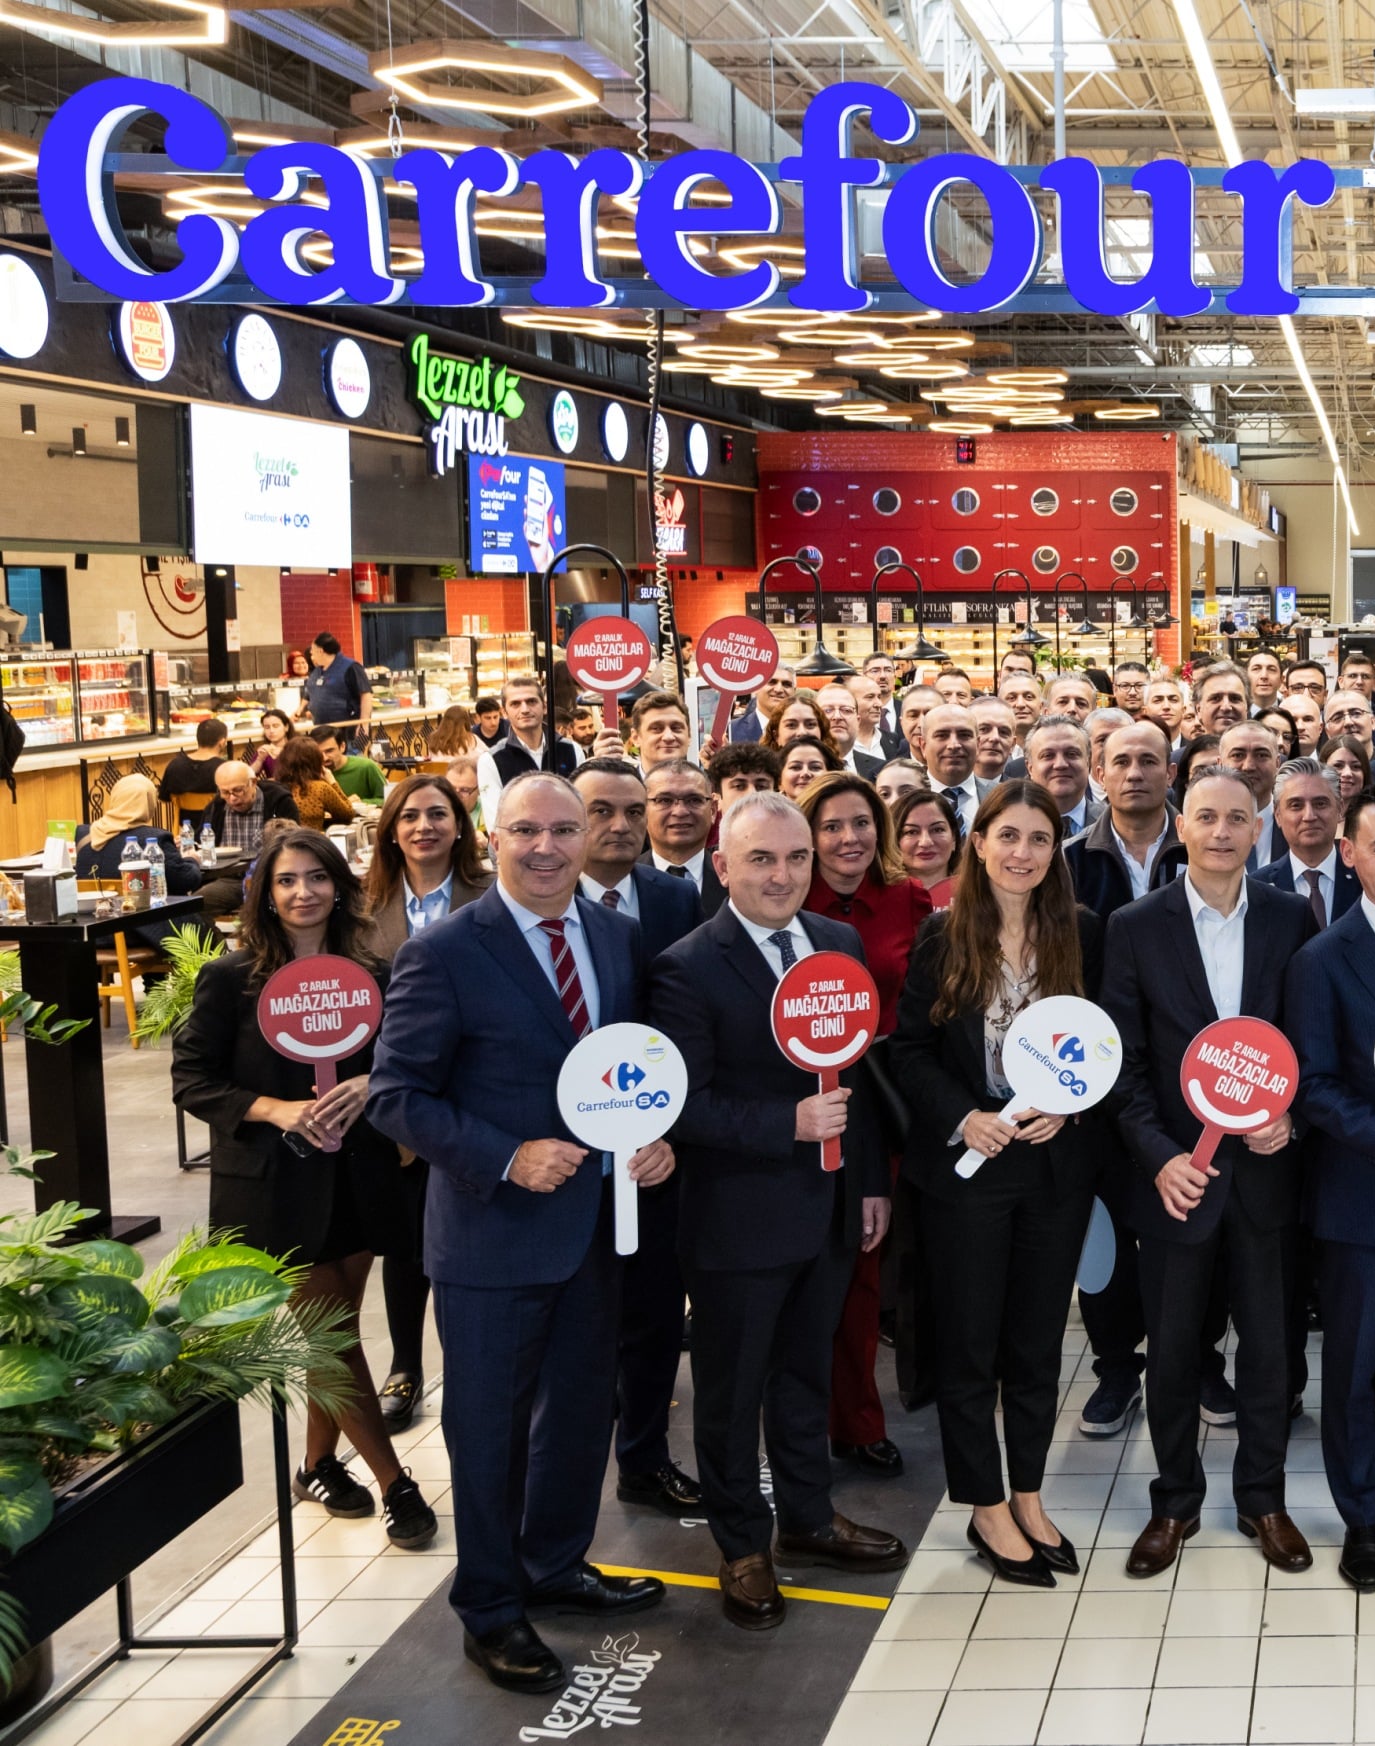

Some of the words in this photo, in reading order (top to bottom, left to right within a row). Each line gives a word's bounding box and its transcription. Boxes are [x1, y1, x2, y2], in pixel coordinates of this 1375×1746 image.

[38, 78, 1335, 315] Carrefour
[338, 381, 366, 395] Chicken
[411, 333, 492, 420] Lezzet
[431, 405, 508, 476] Arası
[244, 511, 278, 523] Carrefour
[574, 641, 643, 657] MAĞAZACILAR
[602, 633, 623, 643] ARALIK
[704, 637, 773, 664] MAĞAZACILAR
[735, 634, 755, 646] ARALIK
[595, 655, 623, 671] GÜNÜ
[721, 655, 750, 674] GÜNÜ
[299, 982, 308, 993] 12
[309, 979, 341, 992] ARALIK
[809, 981, 818, 994] 12
[818, 979, 845, 992] ARALIK
[270, 989, 371, 1016] MAĞAZACILAR
[783, 992, 871, 1018] MAĞAZACILAR
[302, 1011, 342, 1033] GÜNÜ
[811, 1014, 846, 1039] GÜNÜ
[1232, 1041, 1243, 1053] 12
[1240, 1045, 1271, 1066] ARALIK
[1197, 1042, 1289, 1097] MAĞAZACILAR
[1214, 1075, 1255, 1105] GÜNÜ
[591, 1649, 663, 1729] Arası
[518, 1664, 616, 1743] Lezzet
